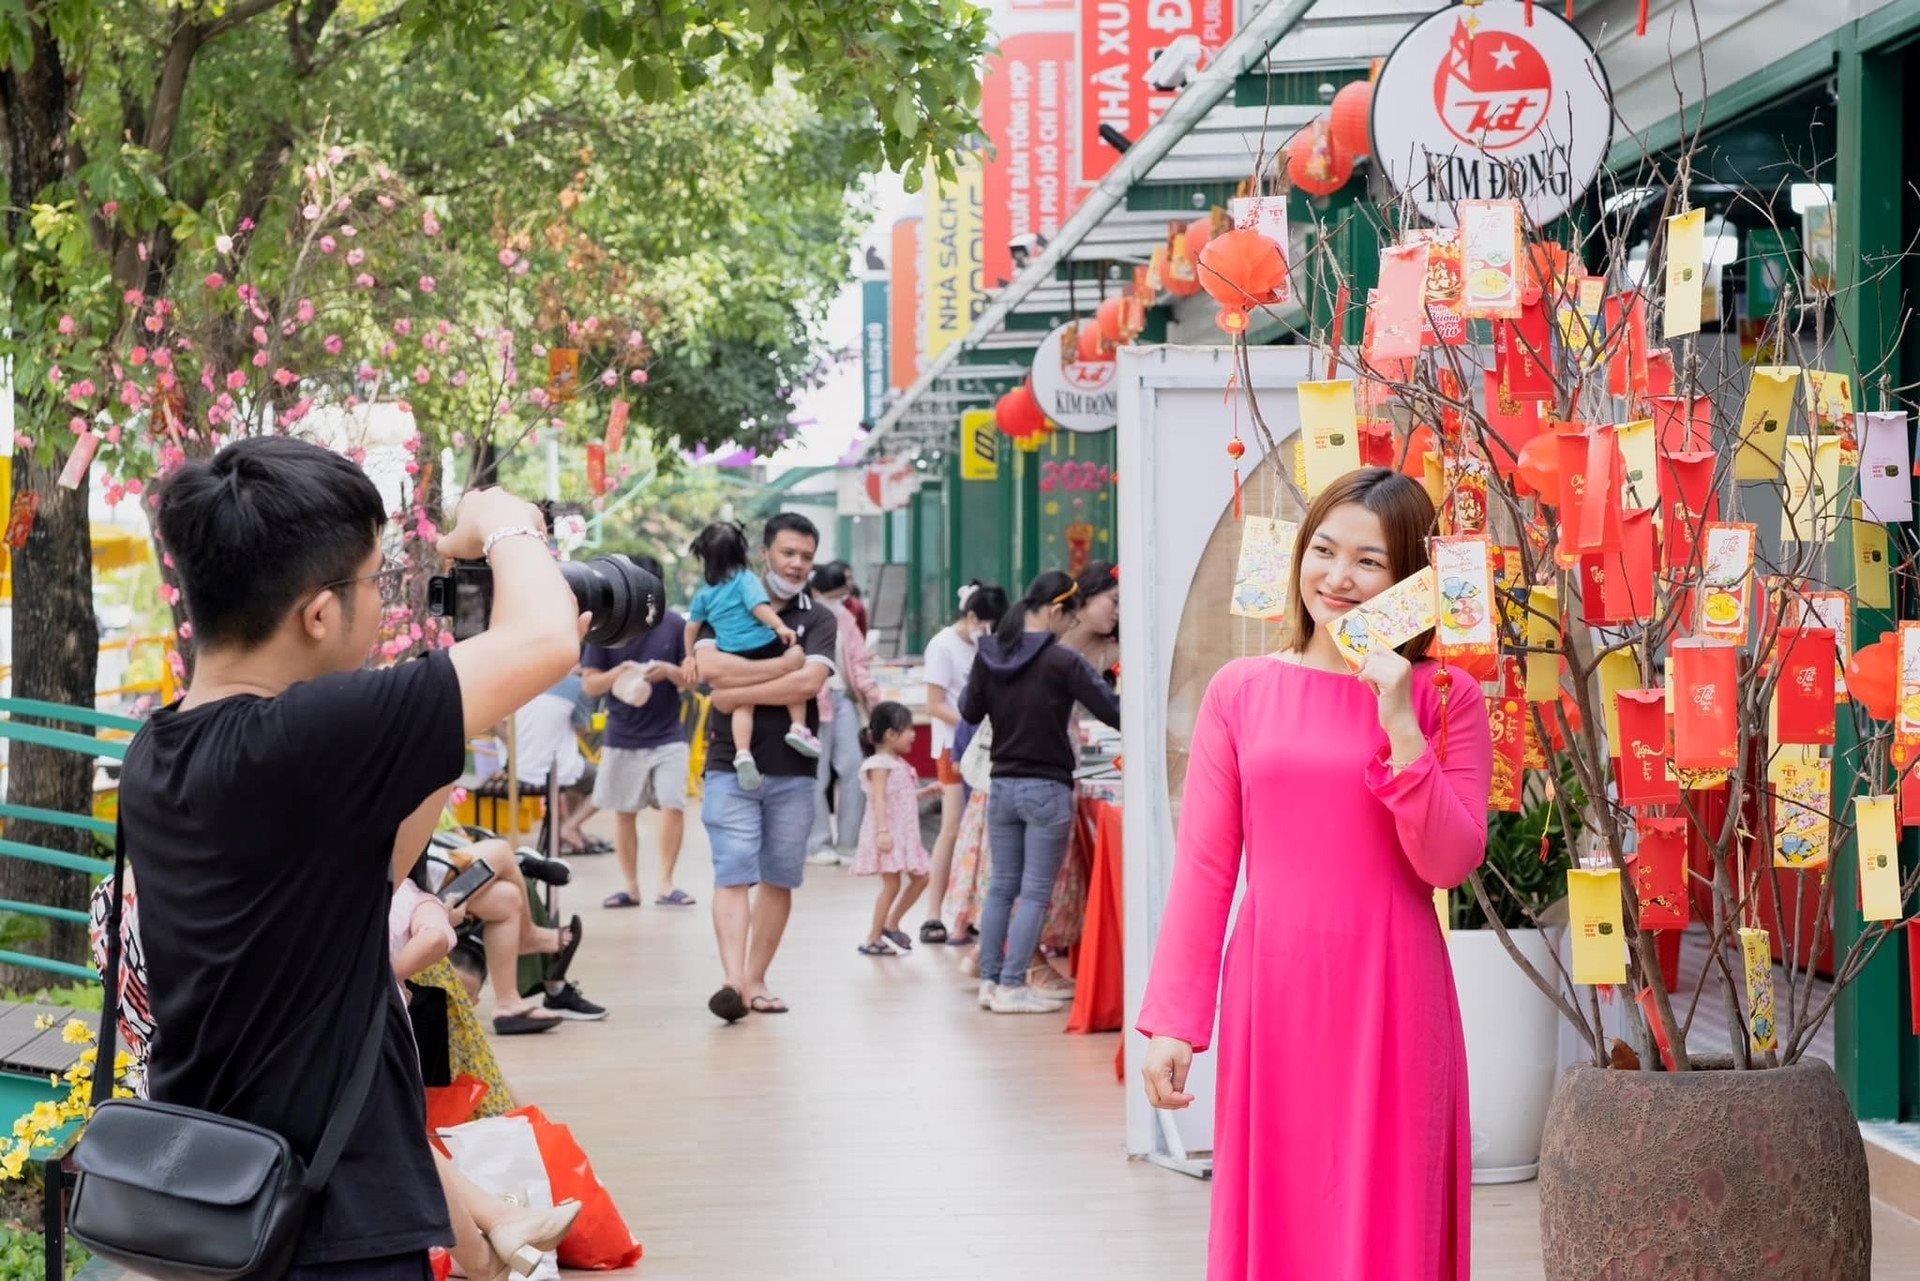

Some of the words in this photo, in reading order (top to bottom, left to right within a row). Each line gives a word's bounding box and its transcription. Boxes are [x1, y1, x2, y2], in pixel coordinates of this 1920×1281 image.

[1098, 0, 1130, 55] XU
[937, 197, 958, 268] SÁCH
[937, 276, 958, 331] NHÀ
[1055, 391, 1082, 415] KIM
